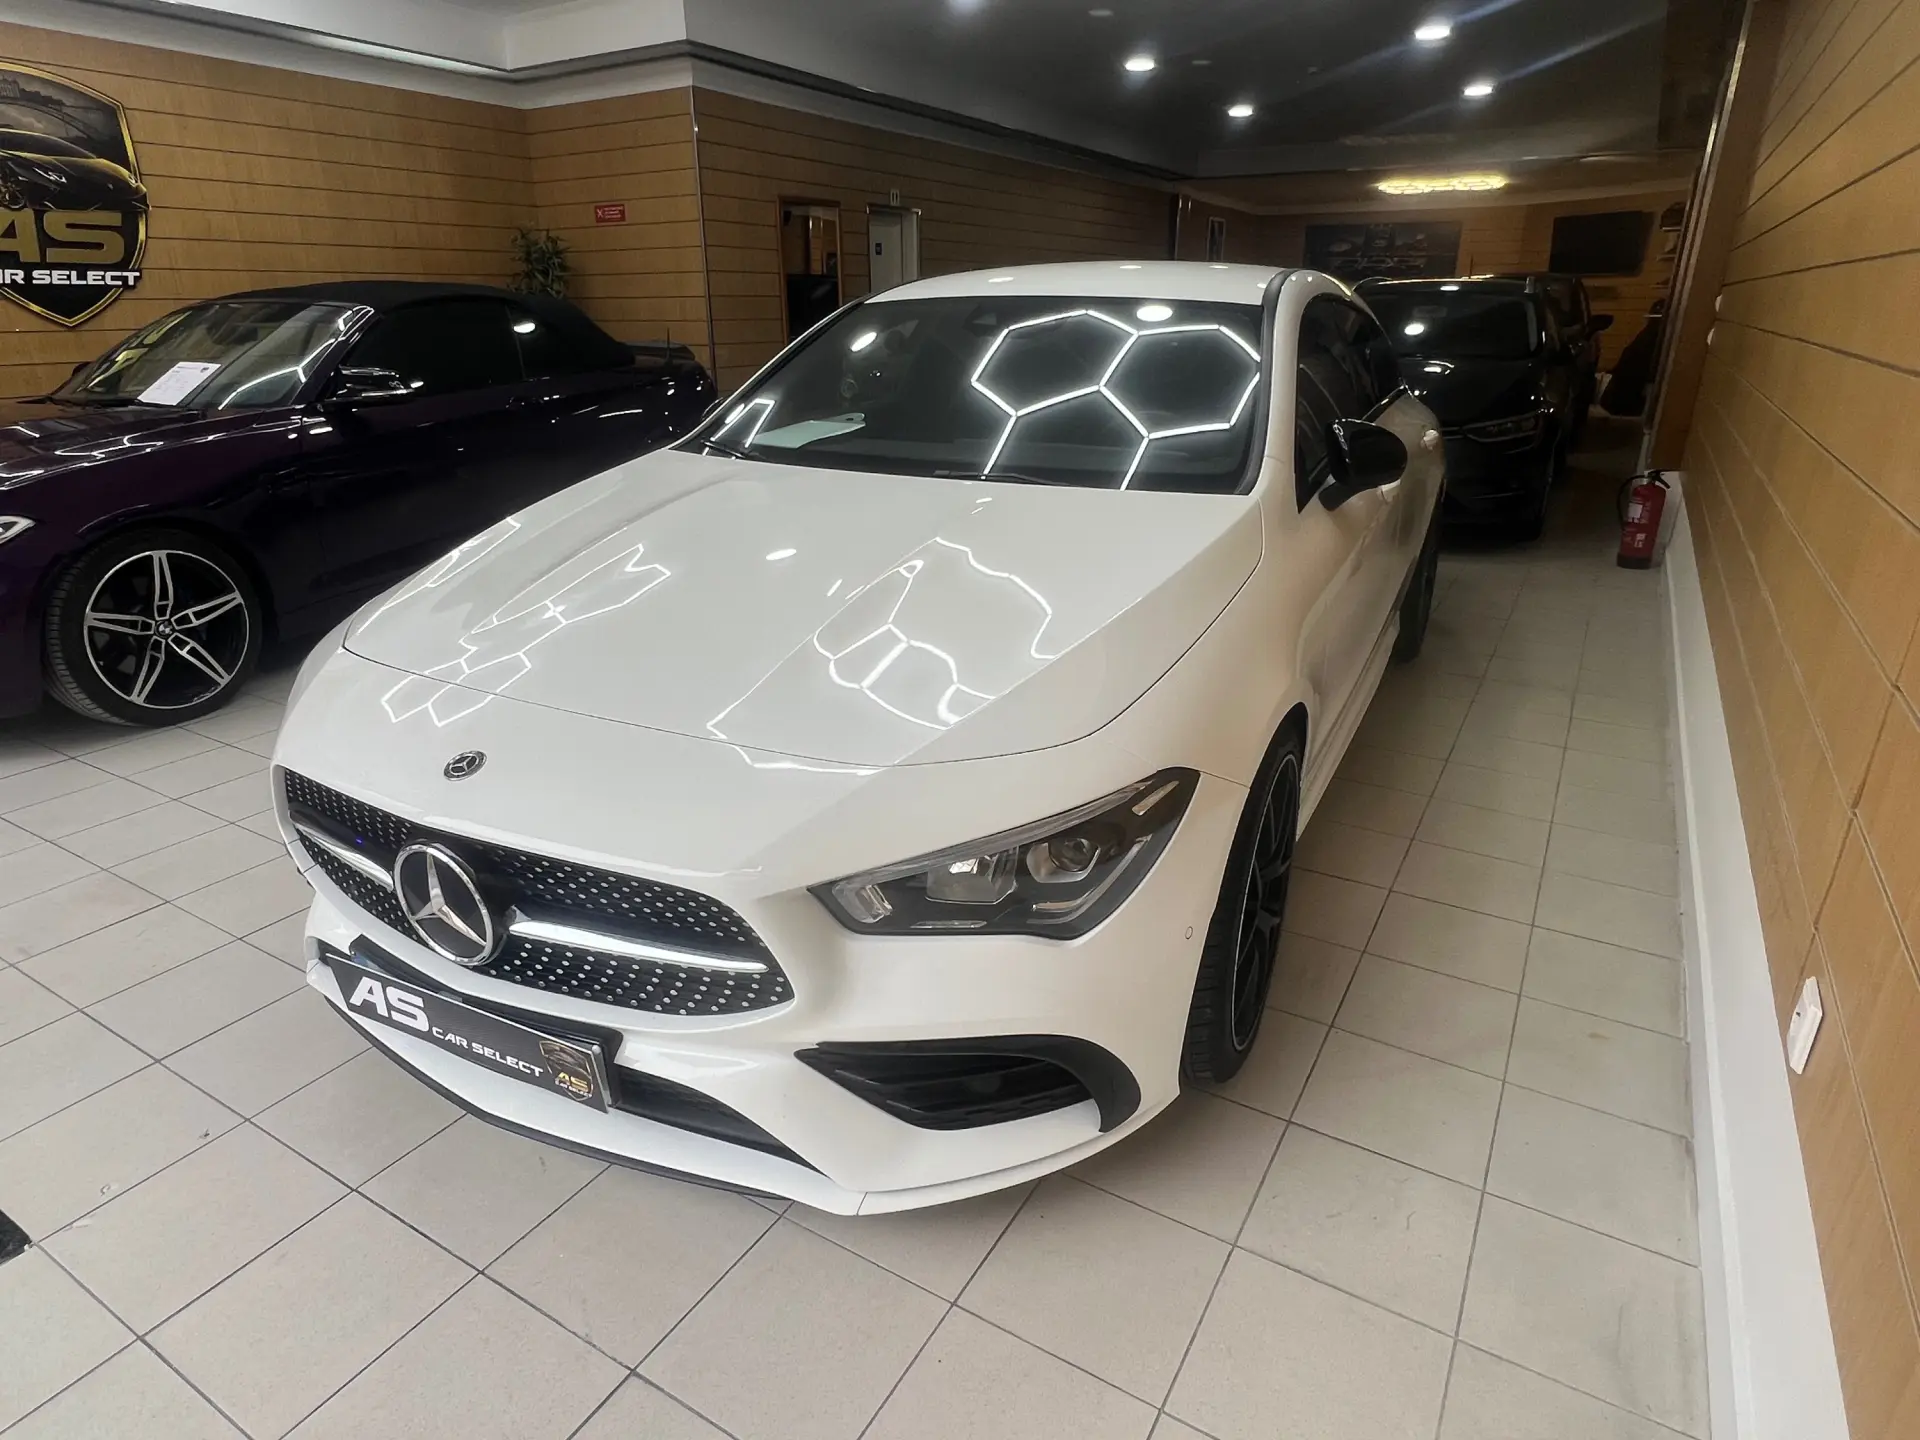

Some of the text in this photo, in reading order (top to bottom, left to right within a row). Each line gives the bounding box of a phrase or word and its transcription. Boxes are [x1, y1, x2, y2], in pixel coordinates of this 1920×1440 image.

[0, 207, 125, 264] AS
[31, 269, 140, 286] SELECT
[349, 976, 544, 1077] AS CAR SELECT
